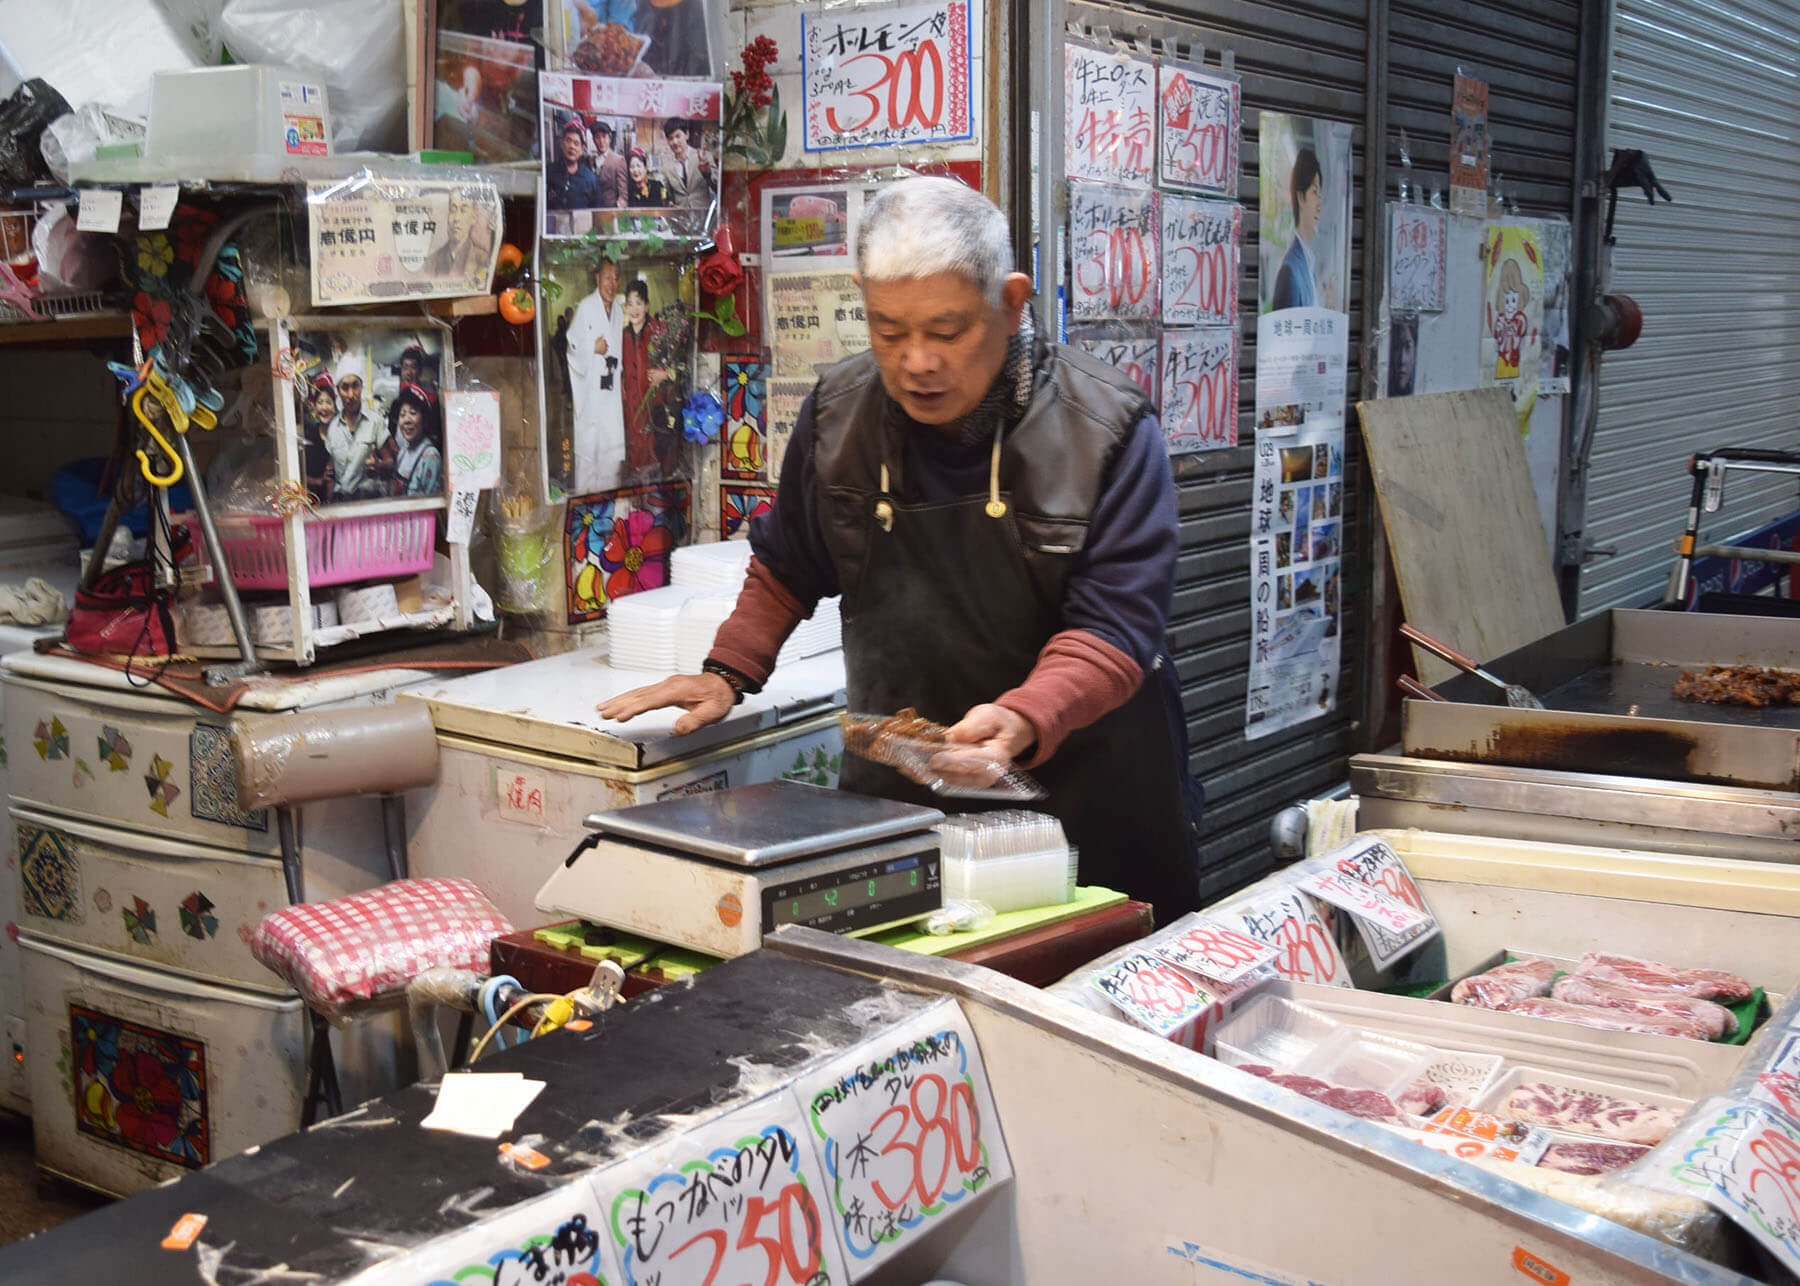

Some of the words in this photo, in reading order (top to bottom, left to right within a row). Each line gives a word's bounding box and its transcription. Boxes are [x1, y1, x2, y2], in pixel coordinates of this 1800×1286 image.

[826, 39, 943, 134] 300
[1077, 227, 1147, 309] 300
[1173, 243, 1227, 316] 200
[1170, 361, 1228, 441] 200
[870, 1073, 982, 1210] 380
